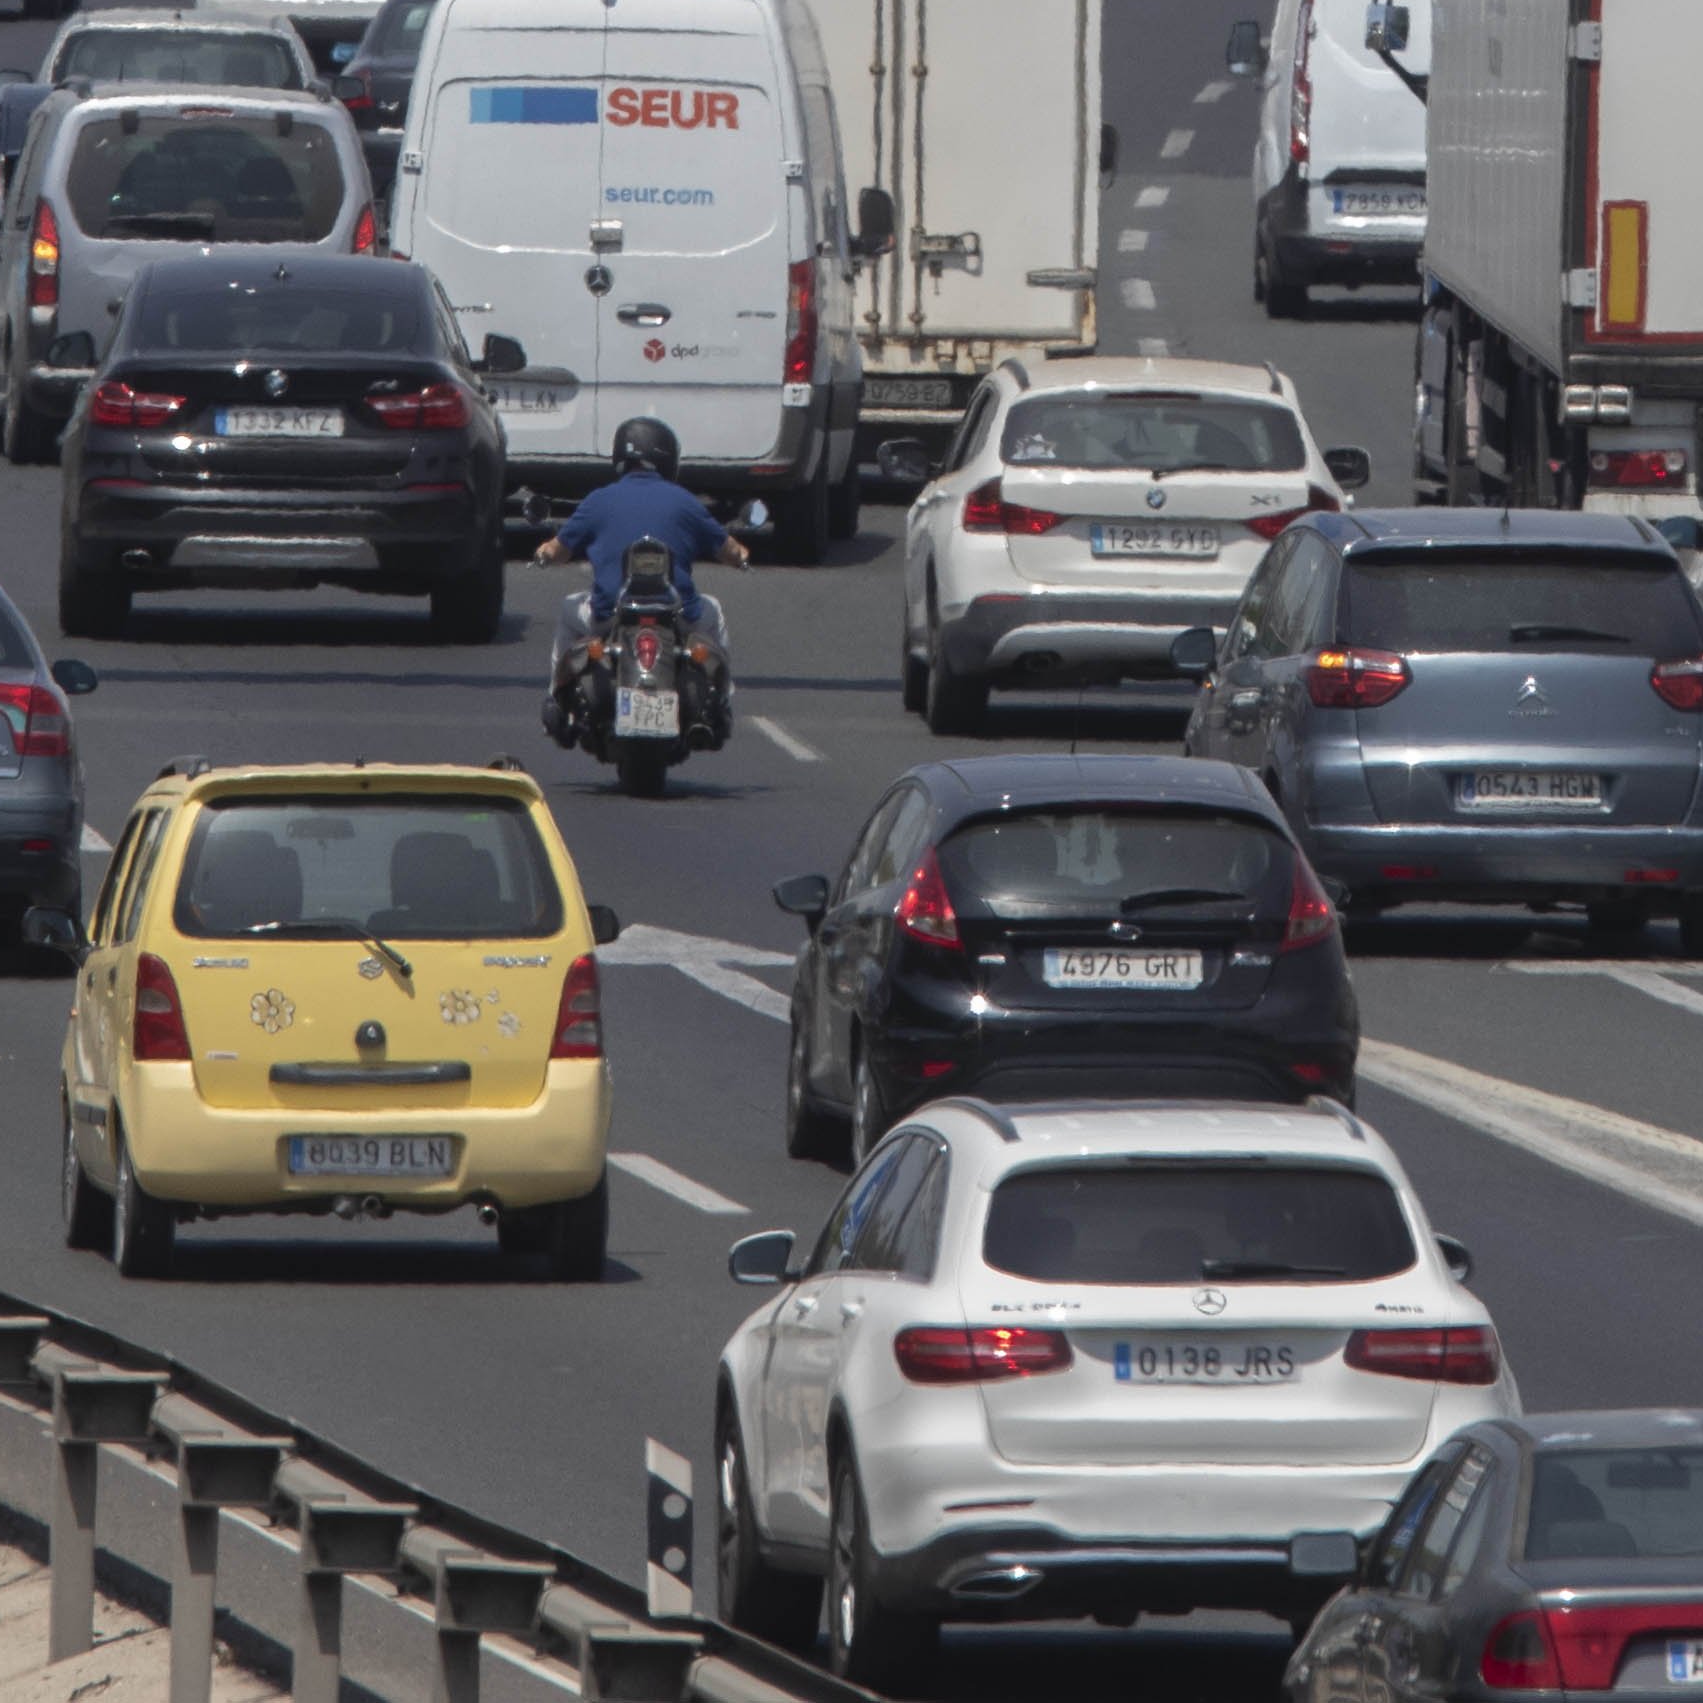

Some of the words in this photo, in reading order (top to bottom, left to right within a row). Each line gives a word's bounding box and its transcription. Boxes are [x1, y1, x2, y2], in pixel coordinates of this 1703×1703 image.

[605, 87, 740, 131] SEUR
[604, 186, 716, 206] seur.com
[233, 409, 287, 431] 1332
[1108, 527, 1162, 550] 1292
[1477, 775, 1539, 797] 0543
[1062, 953, 1130, 977] 4976
[1144, 954, 1194, 978] GRT
[309, 1144, 381, 1166] 8039
[389, 1143, 446, 1167] BLN
[1137, 1346, 1223, 1376] 0138
[1234, 1346, 1296, 1377] JRS
